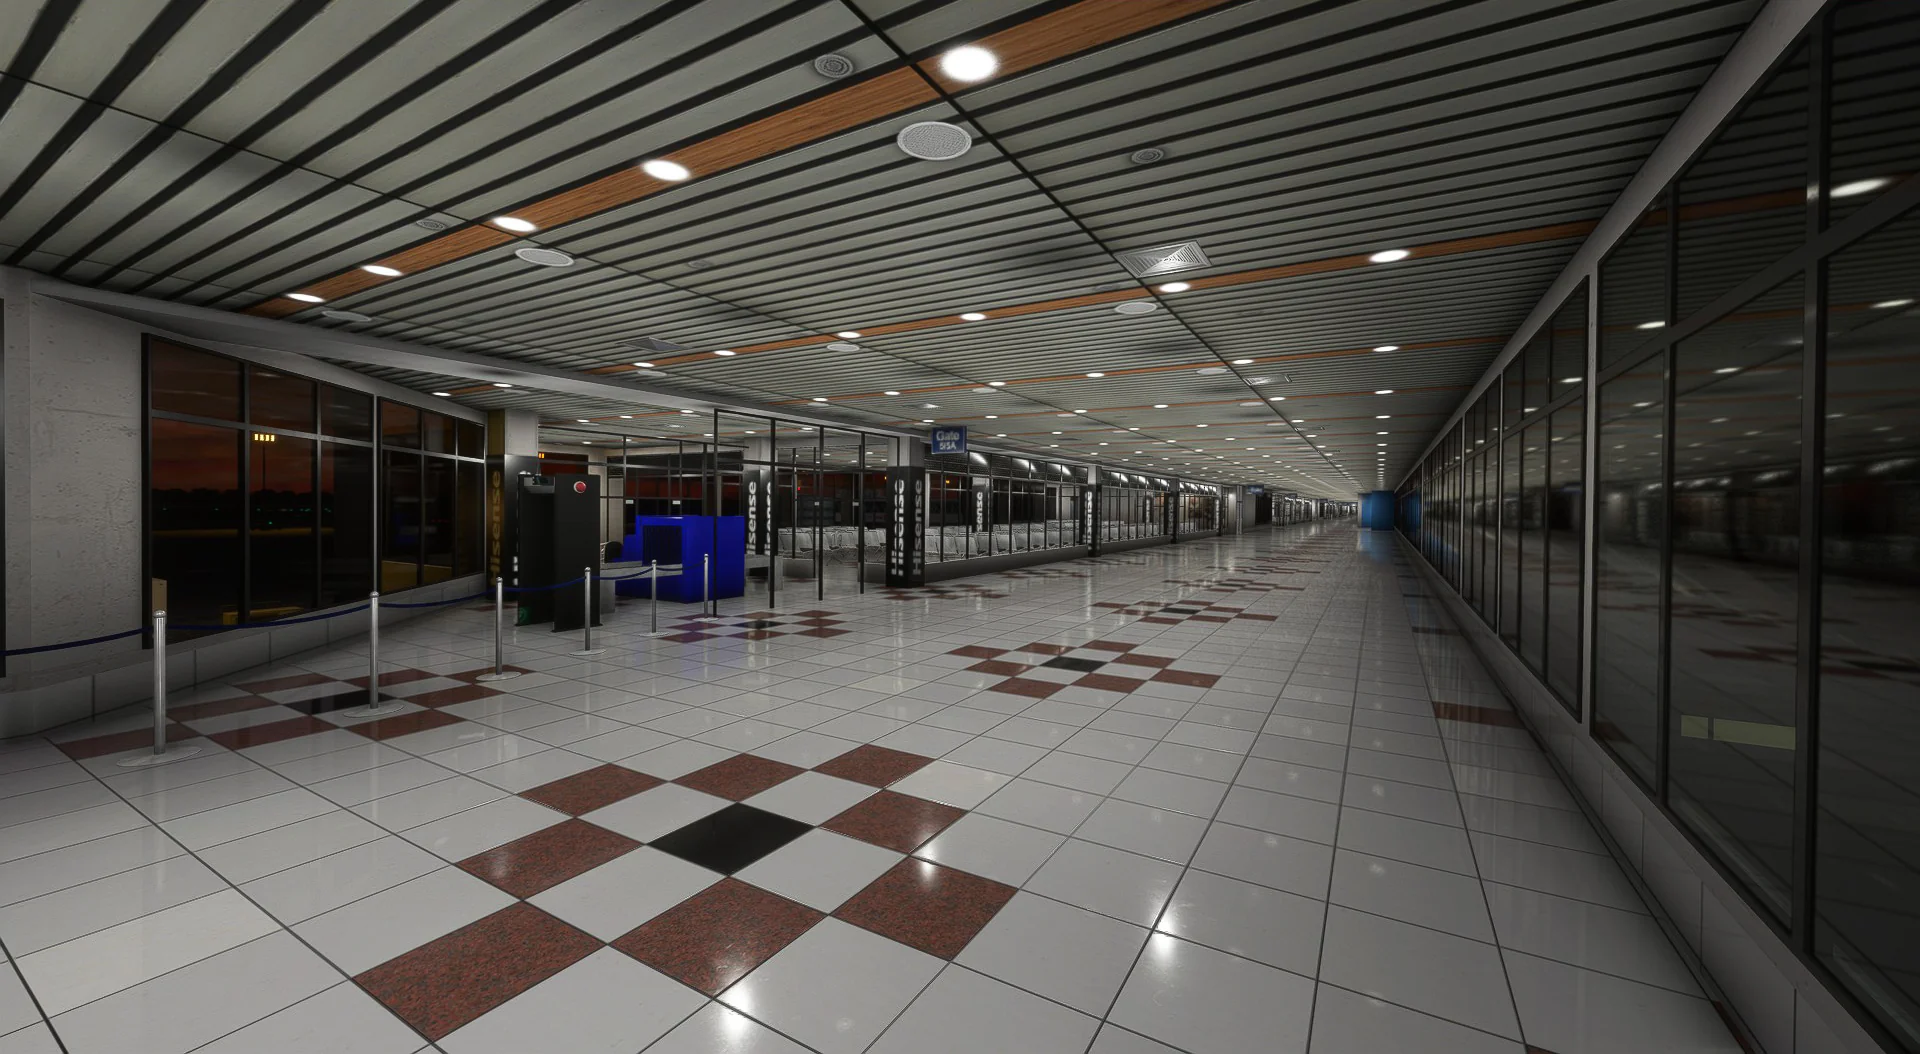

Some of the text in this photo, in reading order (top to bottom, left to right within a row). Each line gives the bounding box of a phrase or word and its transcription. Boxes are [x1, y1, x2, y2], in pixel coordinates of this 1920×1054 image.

[936, 430, 960, 441] Gate
[891, 479, 905, 575] Hisense
[912, 479, 922, 575] Hisense
